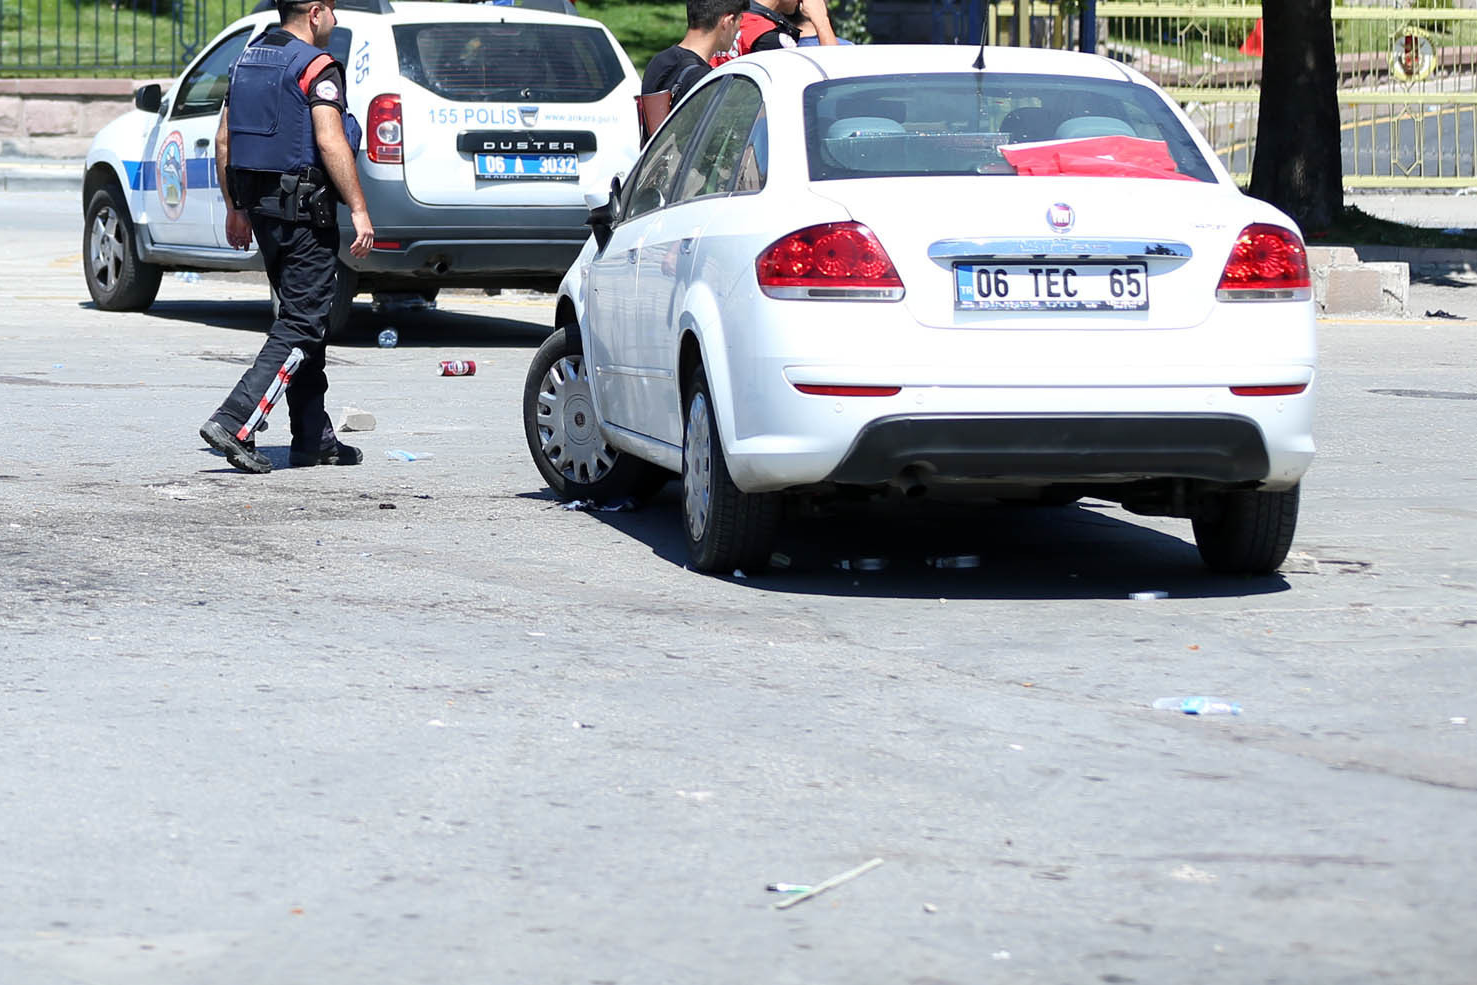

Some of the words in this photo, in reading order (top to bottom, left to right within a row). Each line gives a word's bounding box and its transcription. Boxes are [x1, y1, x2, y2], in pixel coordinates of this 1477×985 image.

[355, 40, 369, 84] 155
[428, 108, 458, 124] 155
[464, 106, 517, 125] POLİS
[483, 141, 575, 150] DUSTER
[485, 154, 506, 174] 06
[514, 154, 525, 174] A
[538, 154, 577, 174] 3032
[960, 285, 973, 296] TR
[976, 268, 1009, 298] 06
[1028, 268, 1078, 298] TEC
[1109, 268, 1141, 298] 65
